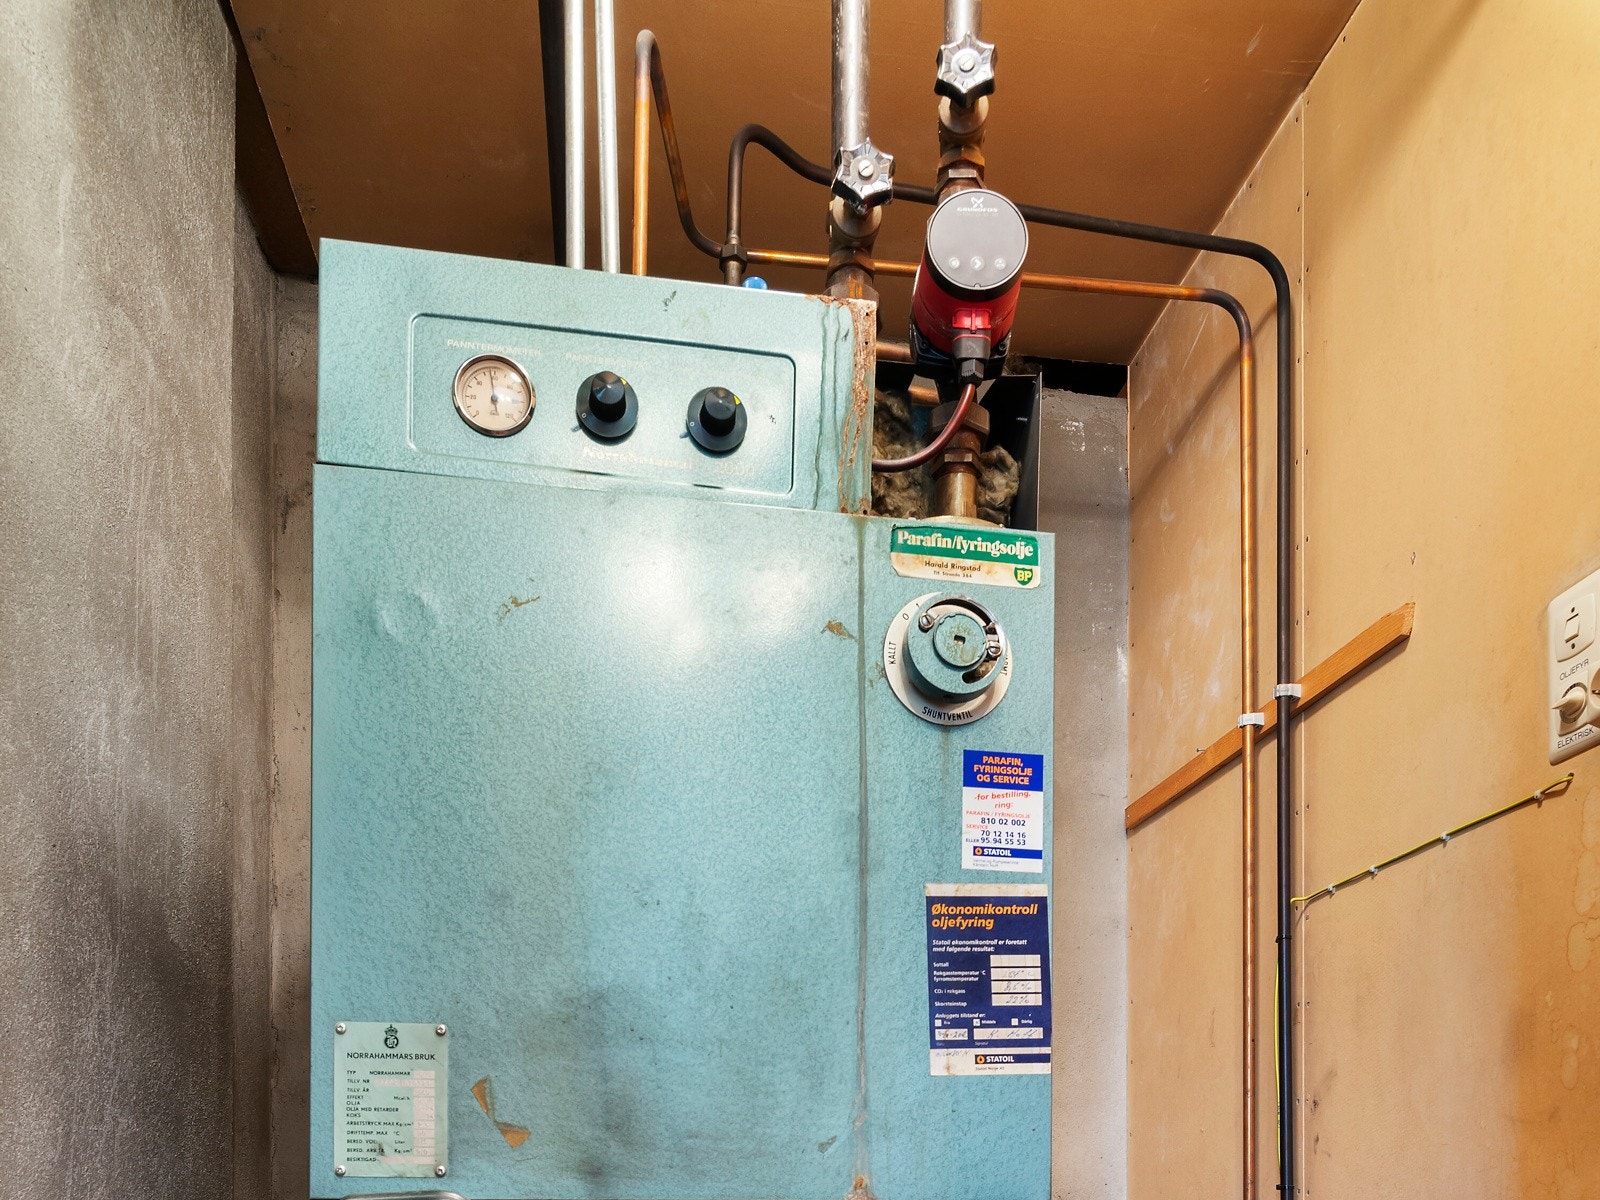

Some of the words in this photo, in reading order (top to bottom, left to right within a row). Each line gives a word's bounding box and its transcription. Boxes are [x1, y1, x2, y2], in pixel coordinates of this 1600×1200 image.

[447, 339, 541, 357] PANNTERMOMETER
[897, 530, 1034, 560] Parafin/fyringsolje
[924, 560, 948, 568] Harald
[950, 562, 981, 572] Ringstad
[1016, 570, 1032, 582] BP
[888, 641, 896, 664] KALLT
[1560, 658, 1589, 680] OLJEFYR
[922, 706, 973, 721] SHUNTVENTIL
[1557, 727, 1594, 749] ELEKTRISK
[982, 756, 1024, 766] PARAFIN,
[974, 764, 1032, 776] FYRINGSOLJE
[976, 774, 990, 782] OG
[993, 776, 1030, 784] SERVICE
[984, 848, 1012, 856] STATOIL
[932, 903, 1038, 915] Økonomikontroll
[932, 916, 994, 930] oljefyring
[346, 1052, 414, 1060] NORRAHAMMARS
